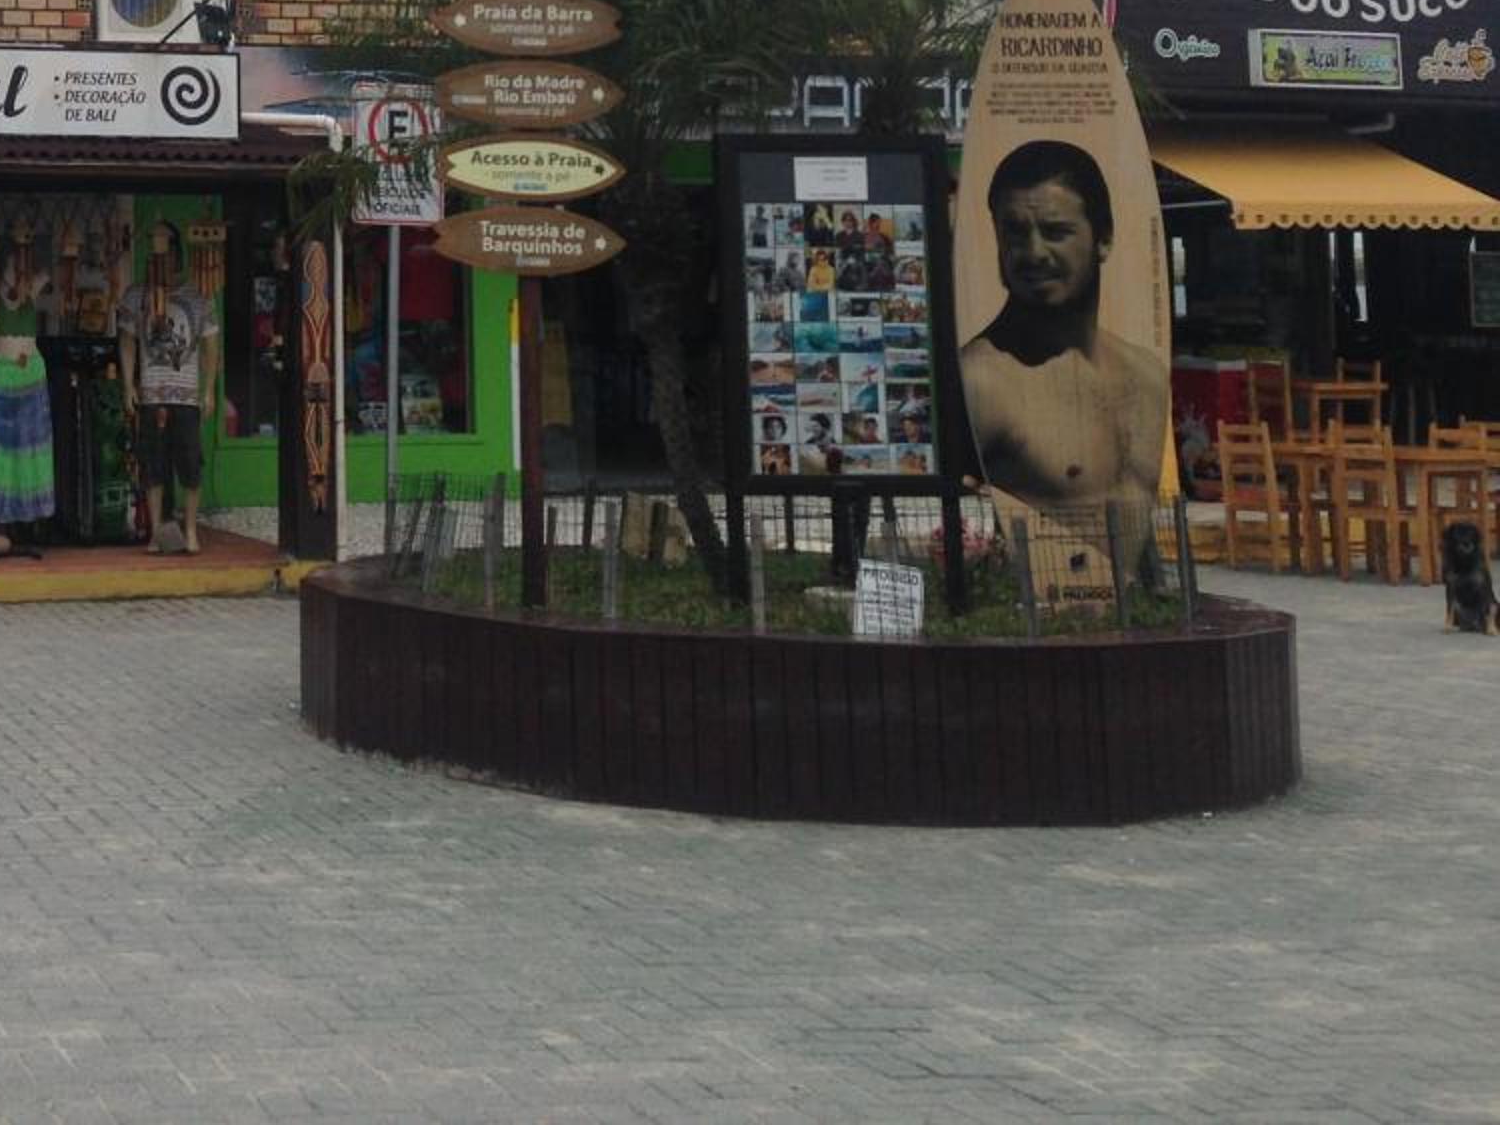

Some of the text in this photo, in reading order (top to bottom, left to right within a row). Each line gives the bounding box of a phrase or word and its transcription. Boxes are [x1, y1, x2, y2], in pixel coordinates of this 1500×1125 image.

[473, 4, 593, 22] Praia da Barra
[1000, 12, 1086, 28] HOMENAGEM
[1001, 37, 1103, 57] RICARDINHO
[65, 70, 138, 87] PRESENTES
[485, 74, 509, 88] Rio
[512, 74, 533, 88] da
[65, 87, 146, 106] DECORAÇÃO
[494, 90, 519, 104] Rio
[65, 108, 117, 123] DE BALI
[471, 150, 592, 168] Acesso à Praia
[479, 220, 586, 239] Travessia de
[482, 237, 583, 256] Barquinhos
